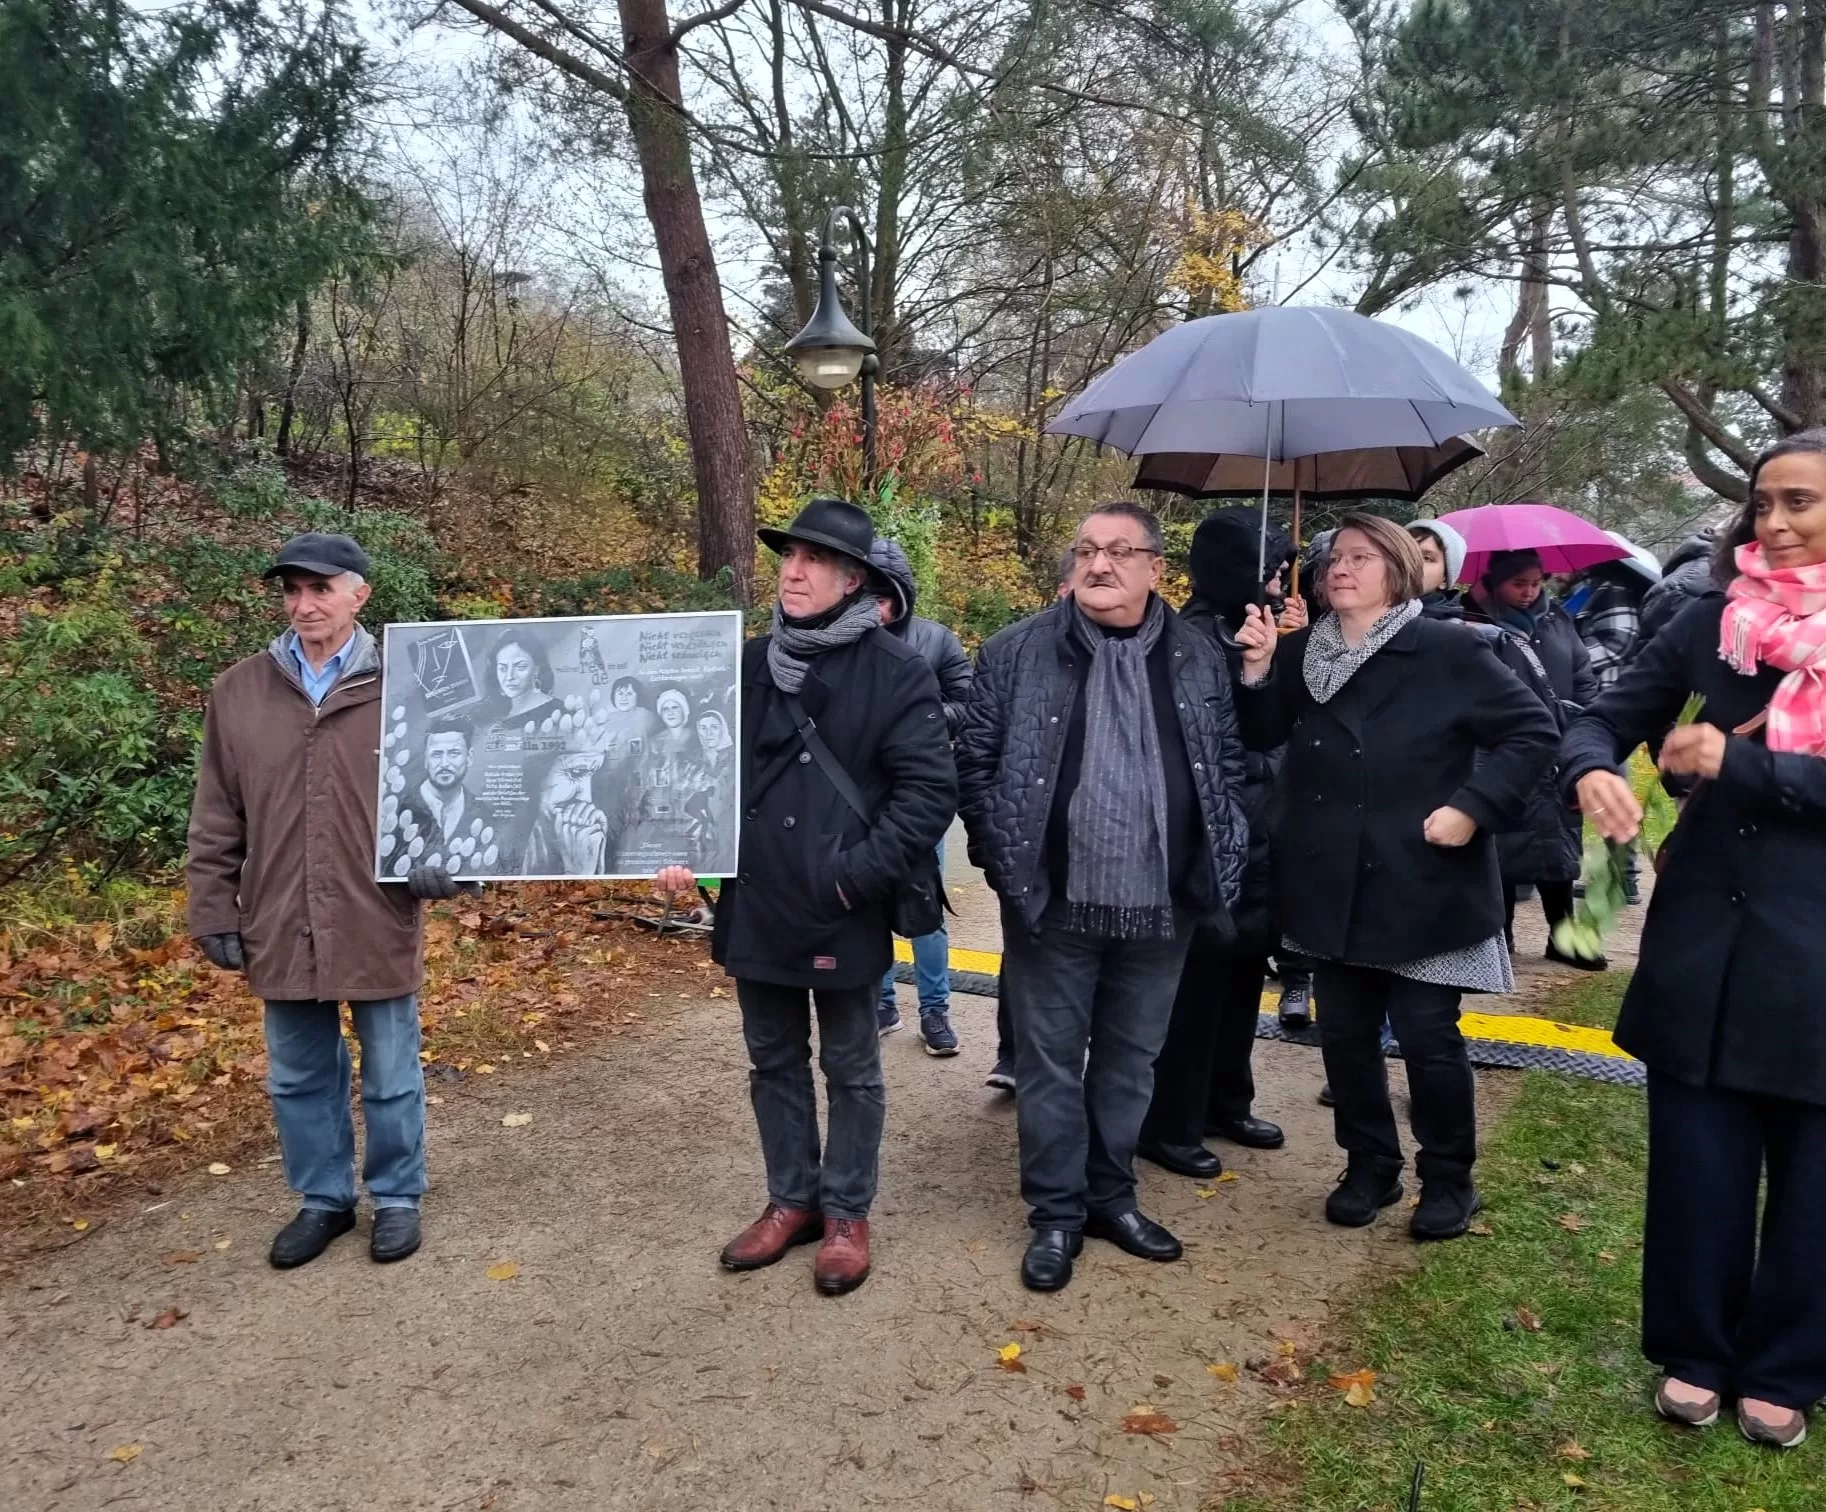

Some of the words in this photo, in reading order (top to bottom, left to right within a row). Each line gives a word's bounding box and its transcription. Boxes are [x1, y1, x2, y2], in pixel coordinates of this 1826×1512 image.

[639, 630, 670, 642] Nicht
[639, 641, 668, 653] Nicht
[639, 651, 669, 664] Nicht
